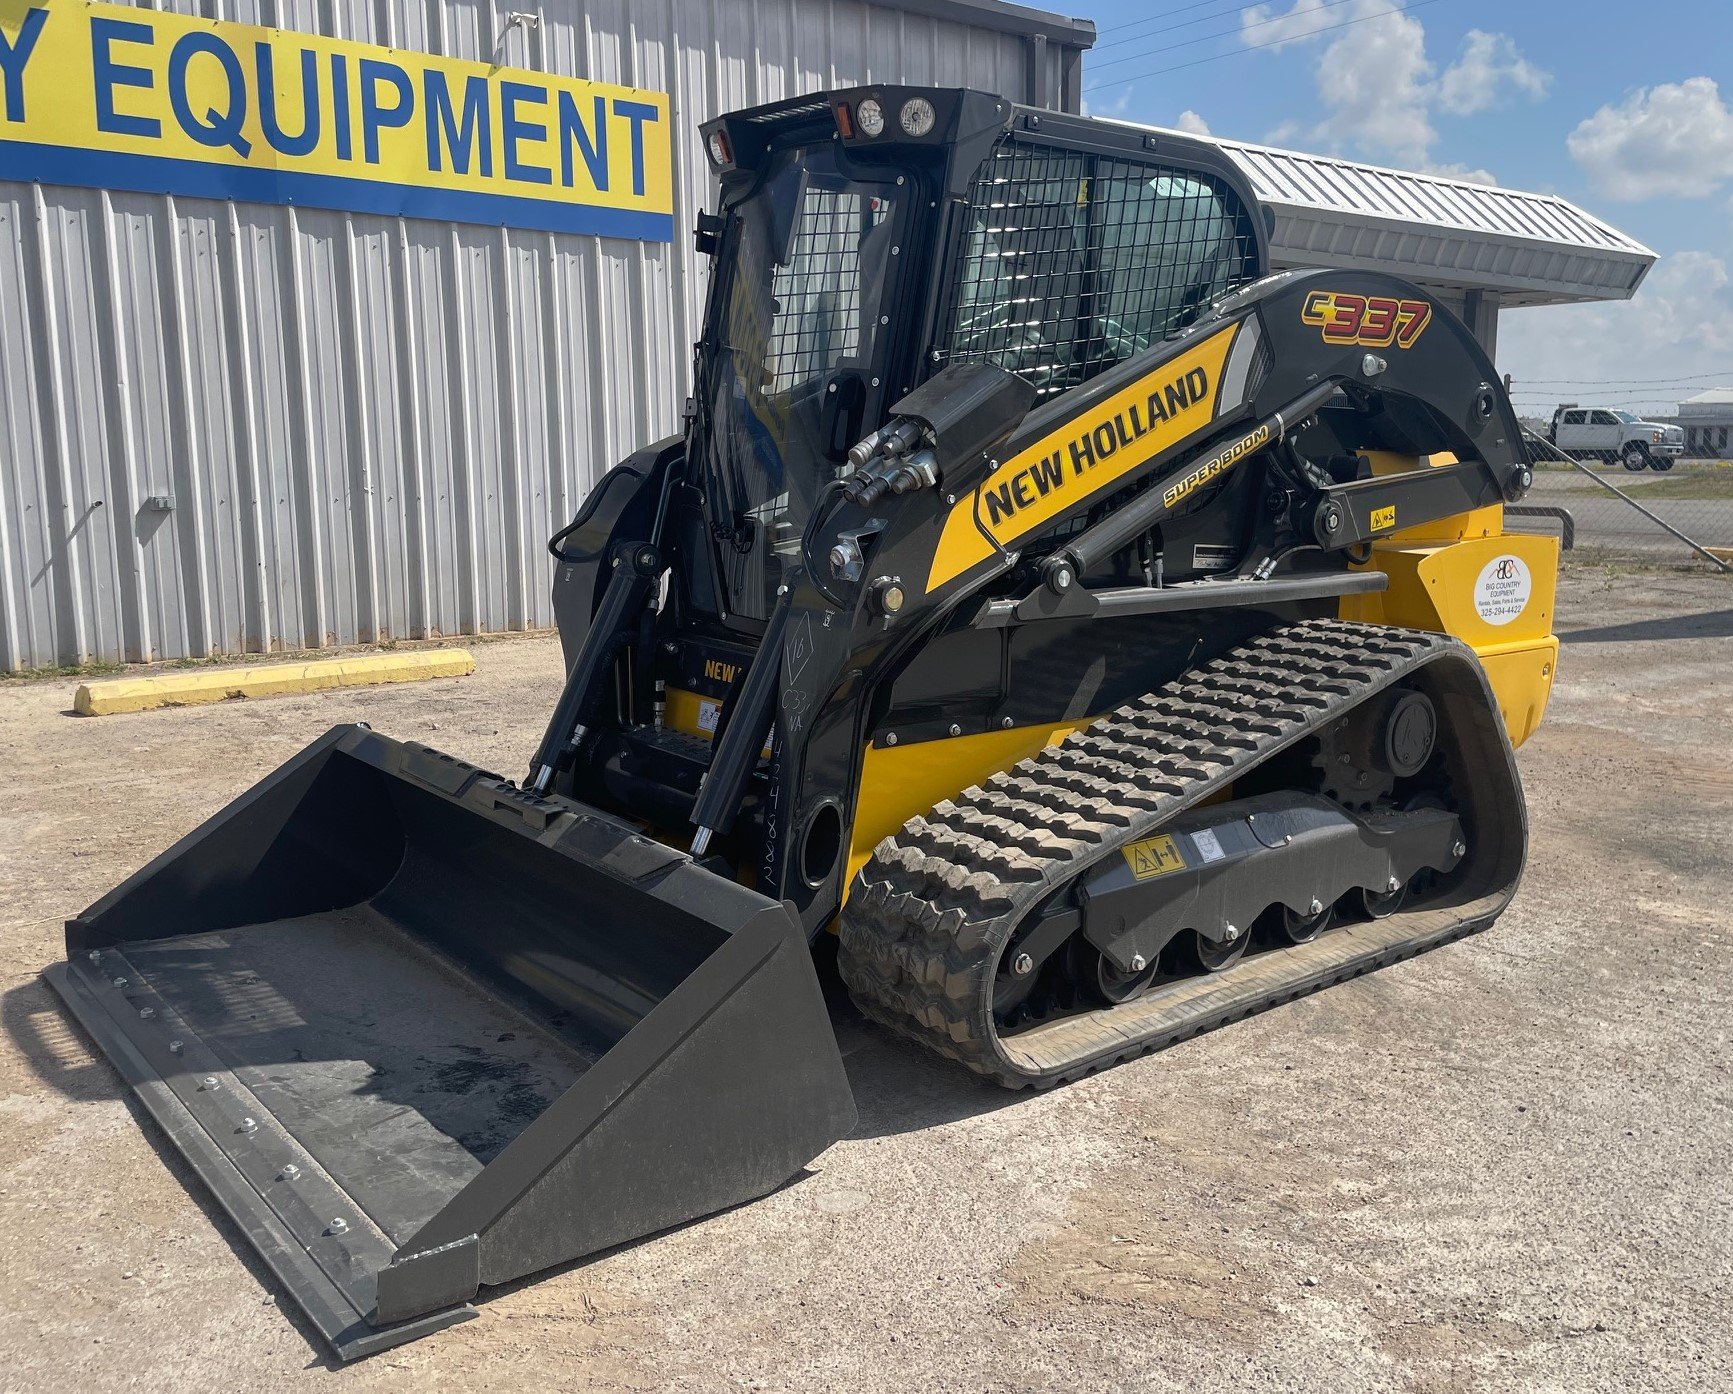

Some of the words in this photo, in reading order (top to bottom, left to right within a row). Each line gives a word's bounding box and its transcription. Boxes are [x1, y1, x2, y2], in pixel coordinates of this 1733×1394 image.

[90, 16, 659, 196] EQUIPMENT
[1302, 290, 1433, 349] C337
[985, 450, 1065, 528] NEW
[1068, 365, 1208, 476] HOLLAND
[1163, 456, 1221, 509] SUPER
[1219, 425, 1269, 470] BOOM
[1485, 583, 1495, 591] BIG
[1495, 581, 1521, 590] COUNTRY
[1490, 589, 1515, 598] EQUIPMENT
[1480, 604, 1522, 617] 325-294-4422
[704, 659, 735, 683] NEW
